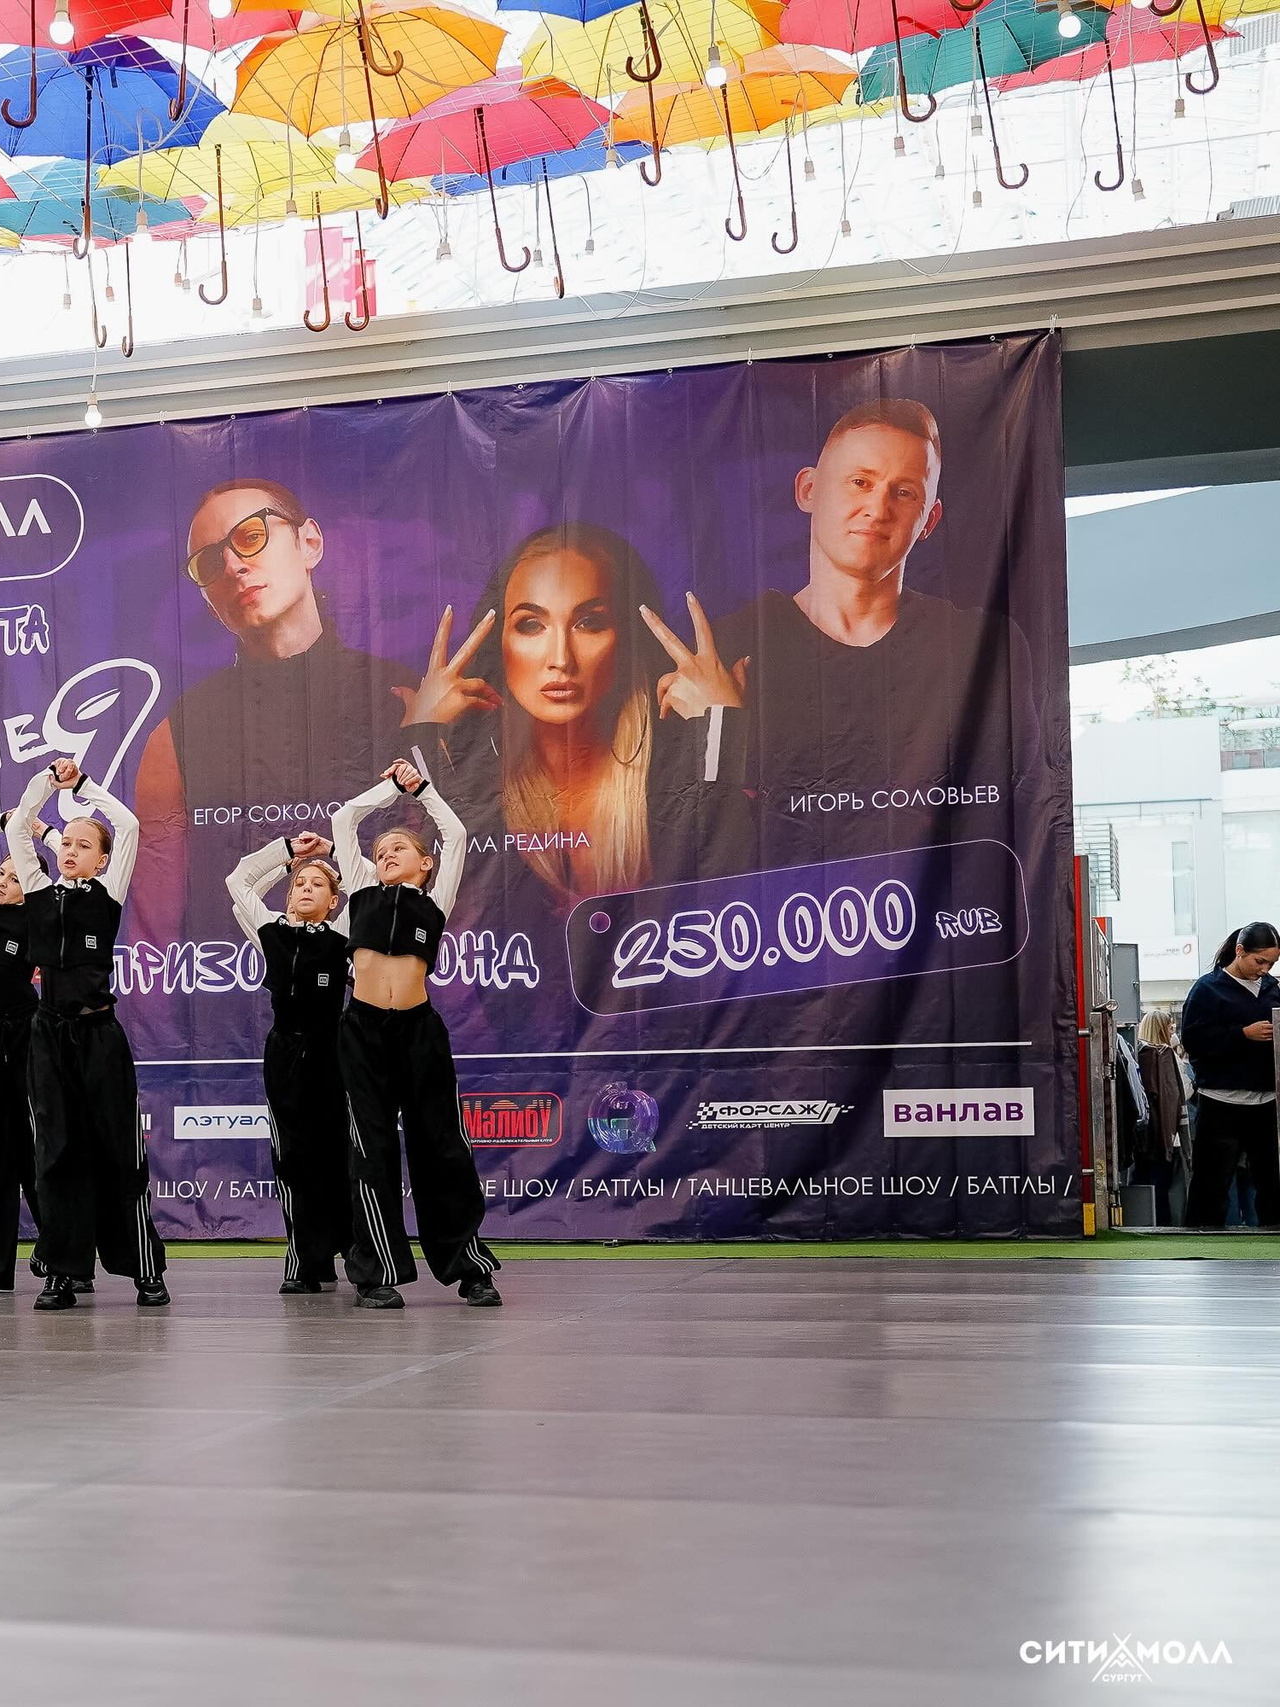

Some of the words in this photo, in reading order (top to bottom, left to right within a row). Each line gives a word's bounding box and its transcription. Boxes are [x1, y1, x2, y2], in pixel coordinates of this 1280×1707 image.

[790, 792, 865, 814] ИГОРЬ
[870, 784, 1001, 808] СОЛОВЬЕВ
[194, 806, 243, 826] ЕГОР
[248, 800, 351, 823] СОКОЛО
[433, 835, 498, 855] МЛА
[504, 831, 591, 853] РЕДИНА
[611, 879, 917, 989] 250.000
[934, 906, 1003, 941] RUB
[112, 940, 268, 996] ПРИЗО
[428, 930, 540, 990] ОНД
[182, 1115, 270, 1129] лэтуал
[718, 1103, 820, 1117] ФОРСАЖ
[893, 1099, 1025, 1124] ванлав
[700, 1121, 739, 1130] ДЕТСКИЙ
[156, 1180, 208, 1199] ШОУ
[230, 1180, 279, 1198] БАТТ
[503, 1178, 558, 1198] ШОУ
[582, 1178, 664, 1197] БАТТЛЫ
[686, 1177, 874, 1200] ТАНЦЕВАЛЬНОЕ
[881, 1176, 942, 1196] ШОУ
[966, 1175, 1056, 1196] БАТТЛЫ
